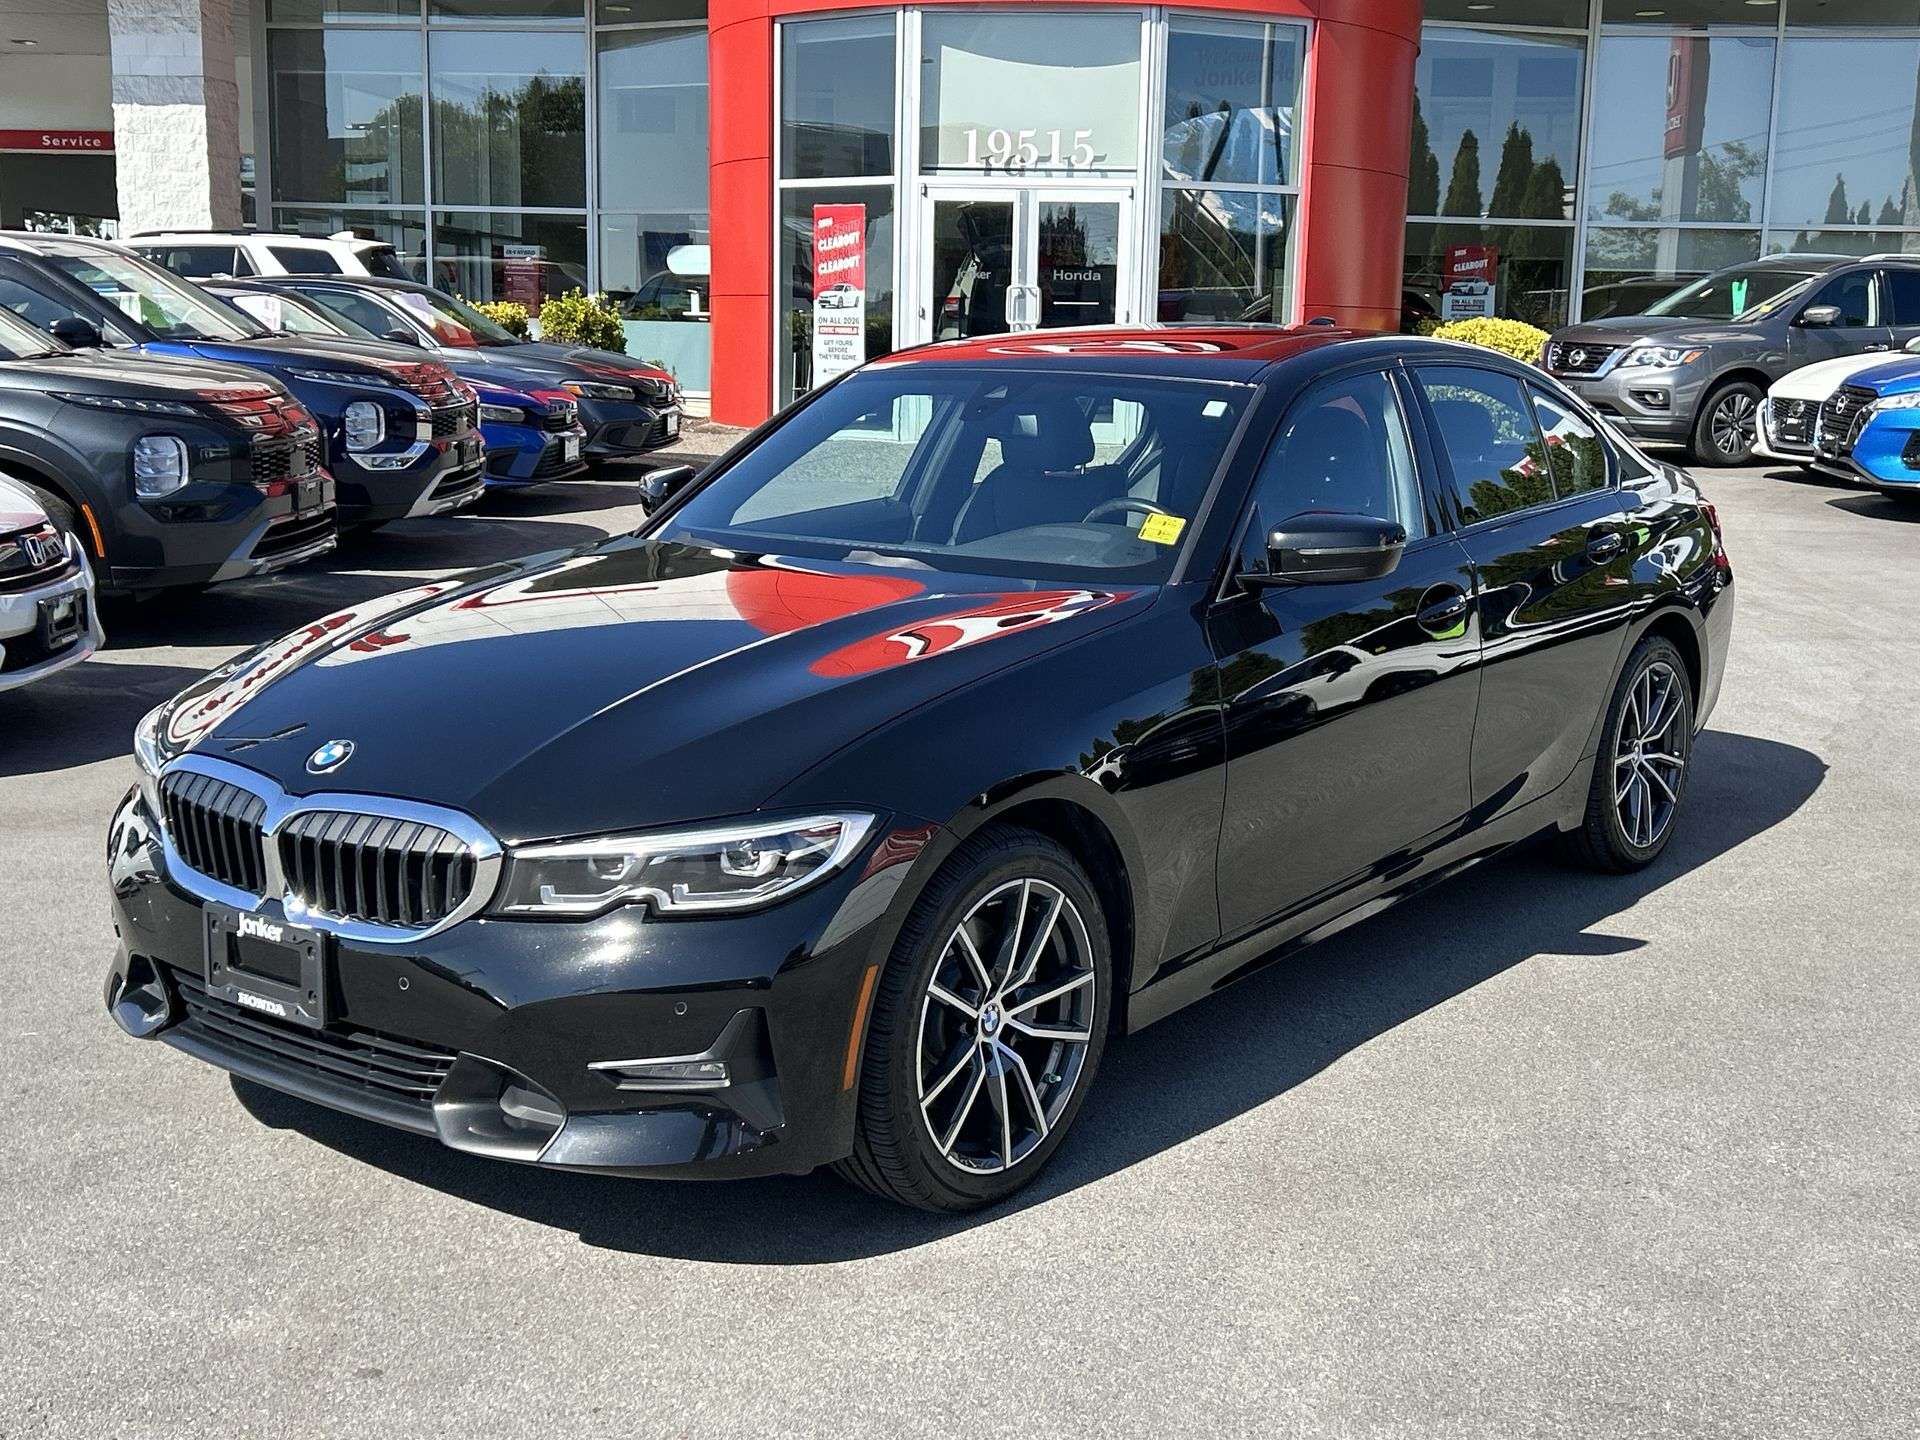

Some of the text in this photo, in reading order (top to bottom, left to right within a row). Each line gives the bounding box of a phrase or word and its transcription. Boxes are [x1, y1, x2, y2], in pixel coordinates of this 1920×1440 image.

[41, 135, 102, 147] Service
[963, 128, 1095, 168] 19515
[818, 231, 860, 252] CLEAROUT
[818, 255, 860, 275] CLEAROUT
[1453, 259, 1489, 273] CLEAROUT
[1053, 269, 1101, 281] Honda
[818, 316, 828, 325] ON
[830, 316, 842, 325] ALL
[237, 991, 287, 1017] HONDA
